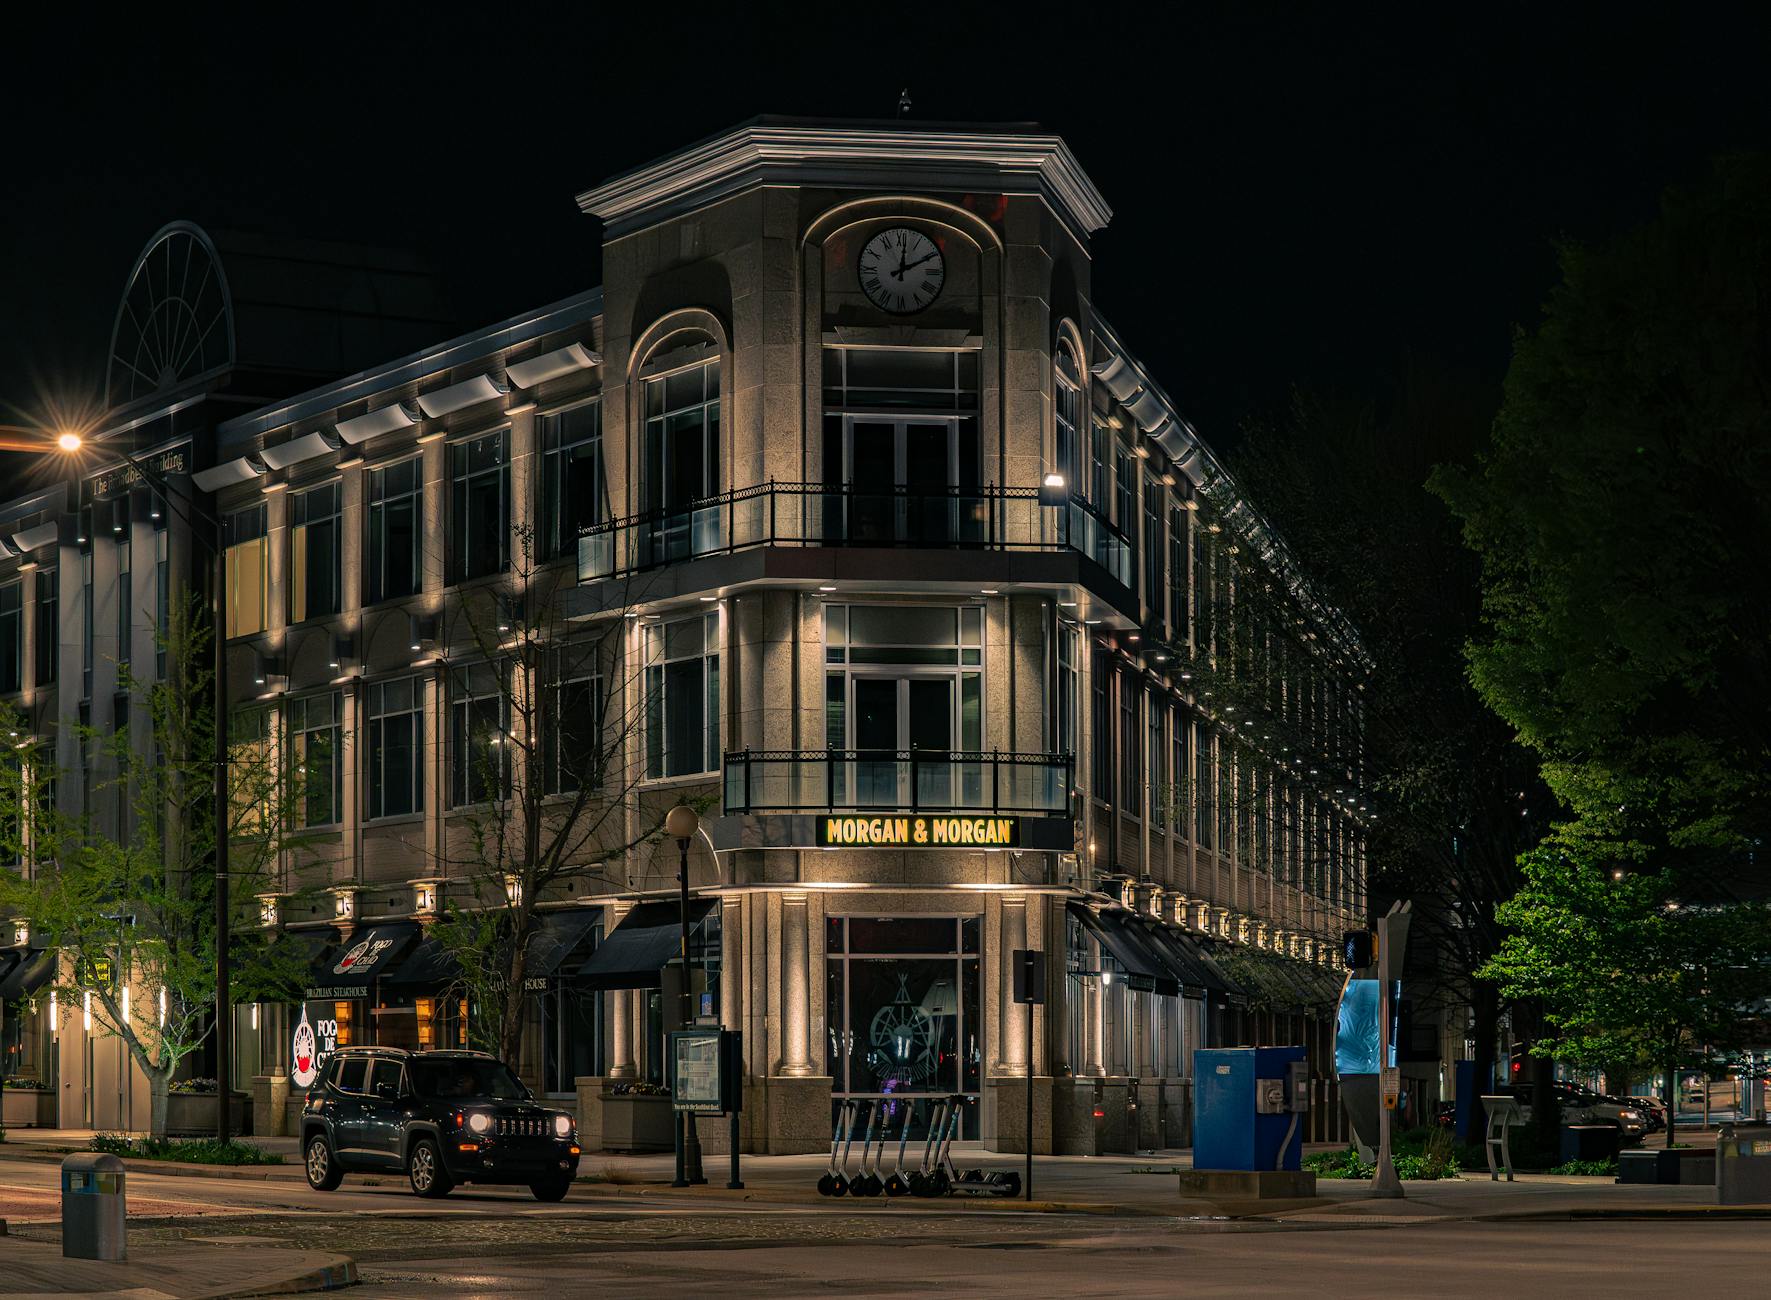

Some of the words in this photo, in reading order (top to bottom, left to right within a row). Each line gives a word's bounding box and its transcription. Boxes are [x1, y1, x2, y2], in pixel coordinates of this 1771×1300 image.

[94, 477, 109, 496] The
[827, 819, 908, 843] MORGAN
[913, 819, 928, 843] &
[933, 819, 1010, 844] MORGAN
[306, 987, 333, 998] BRAZILIAN
[333, 986, 368, 997] STEAKHOUSE
[317, 1020, 337, 1037] FOG
[324, 1037, 336, 1052] DE
